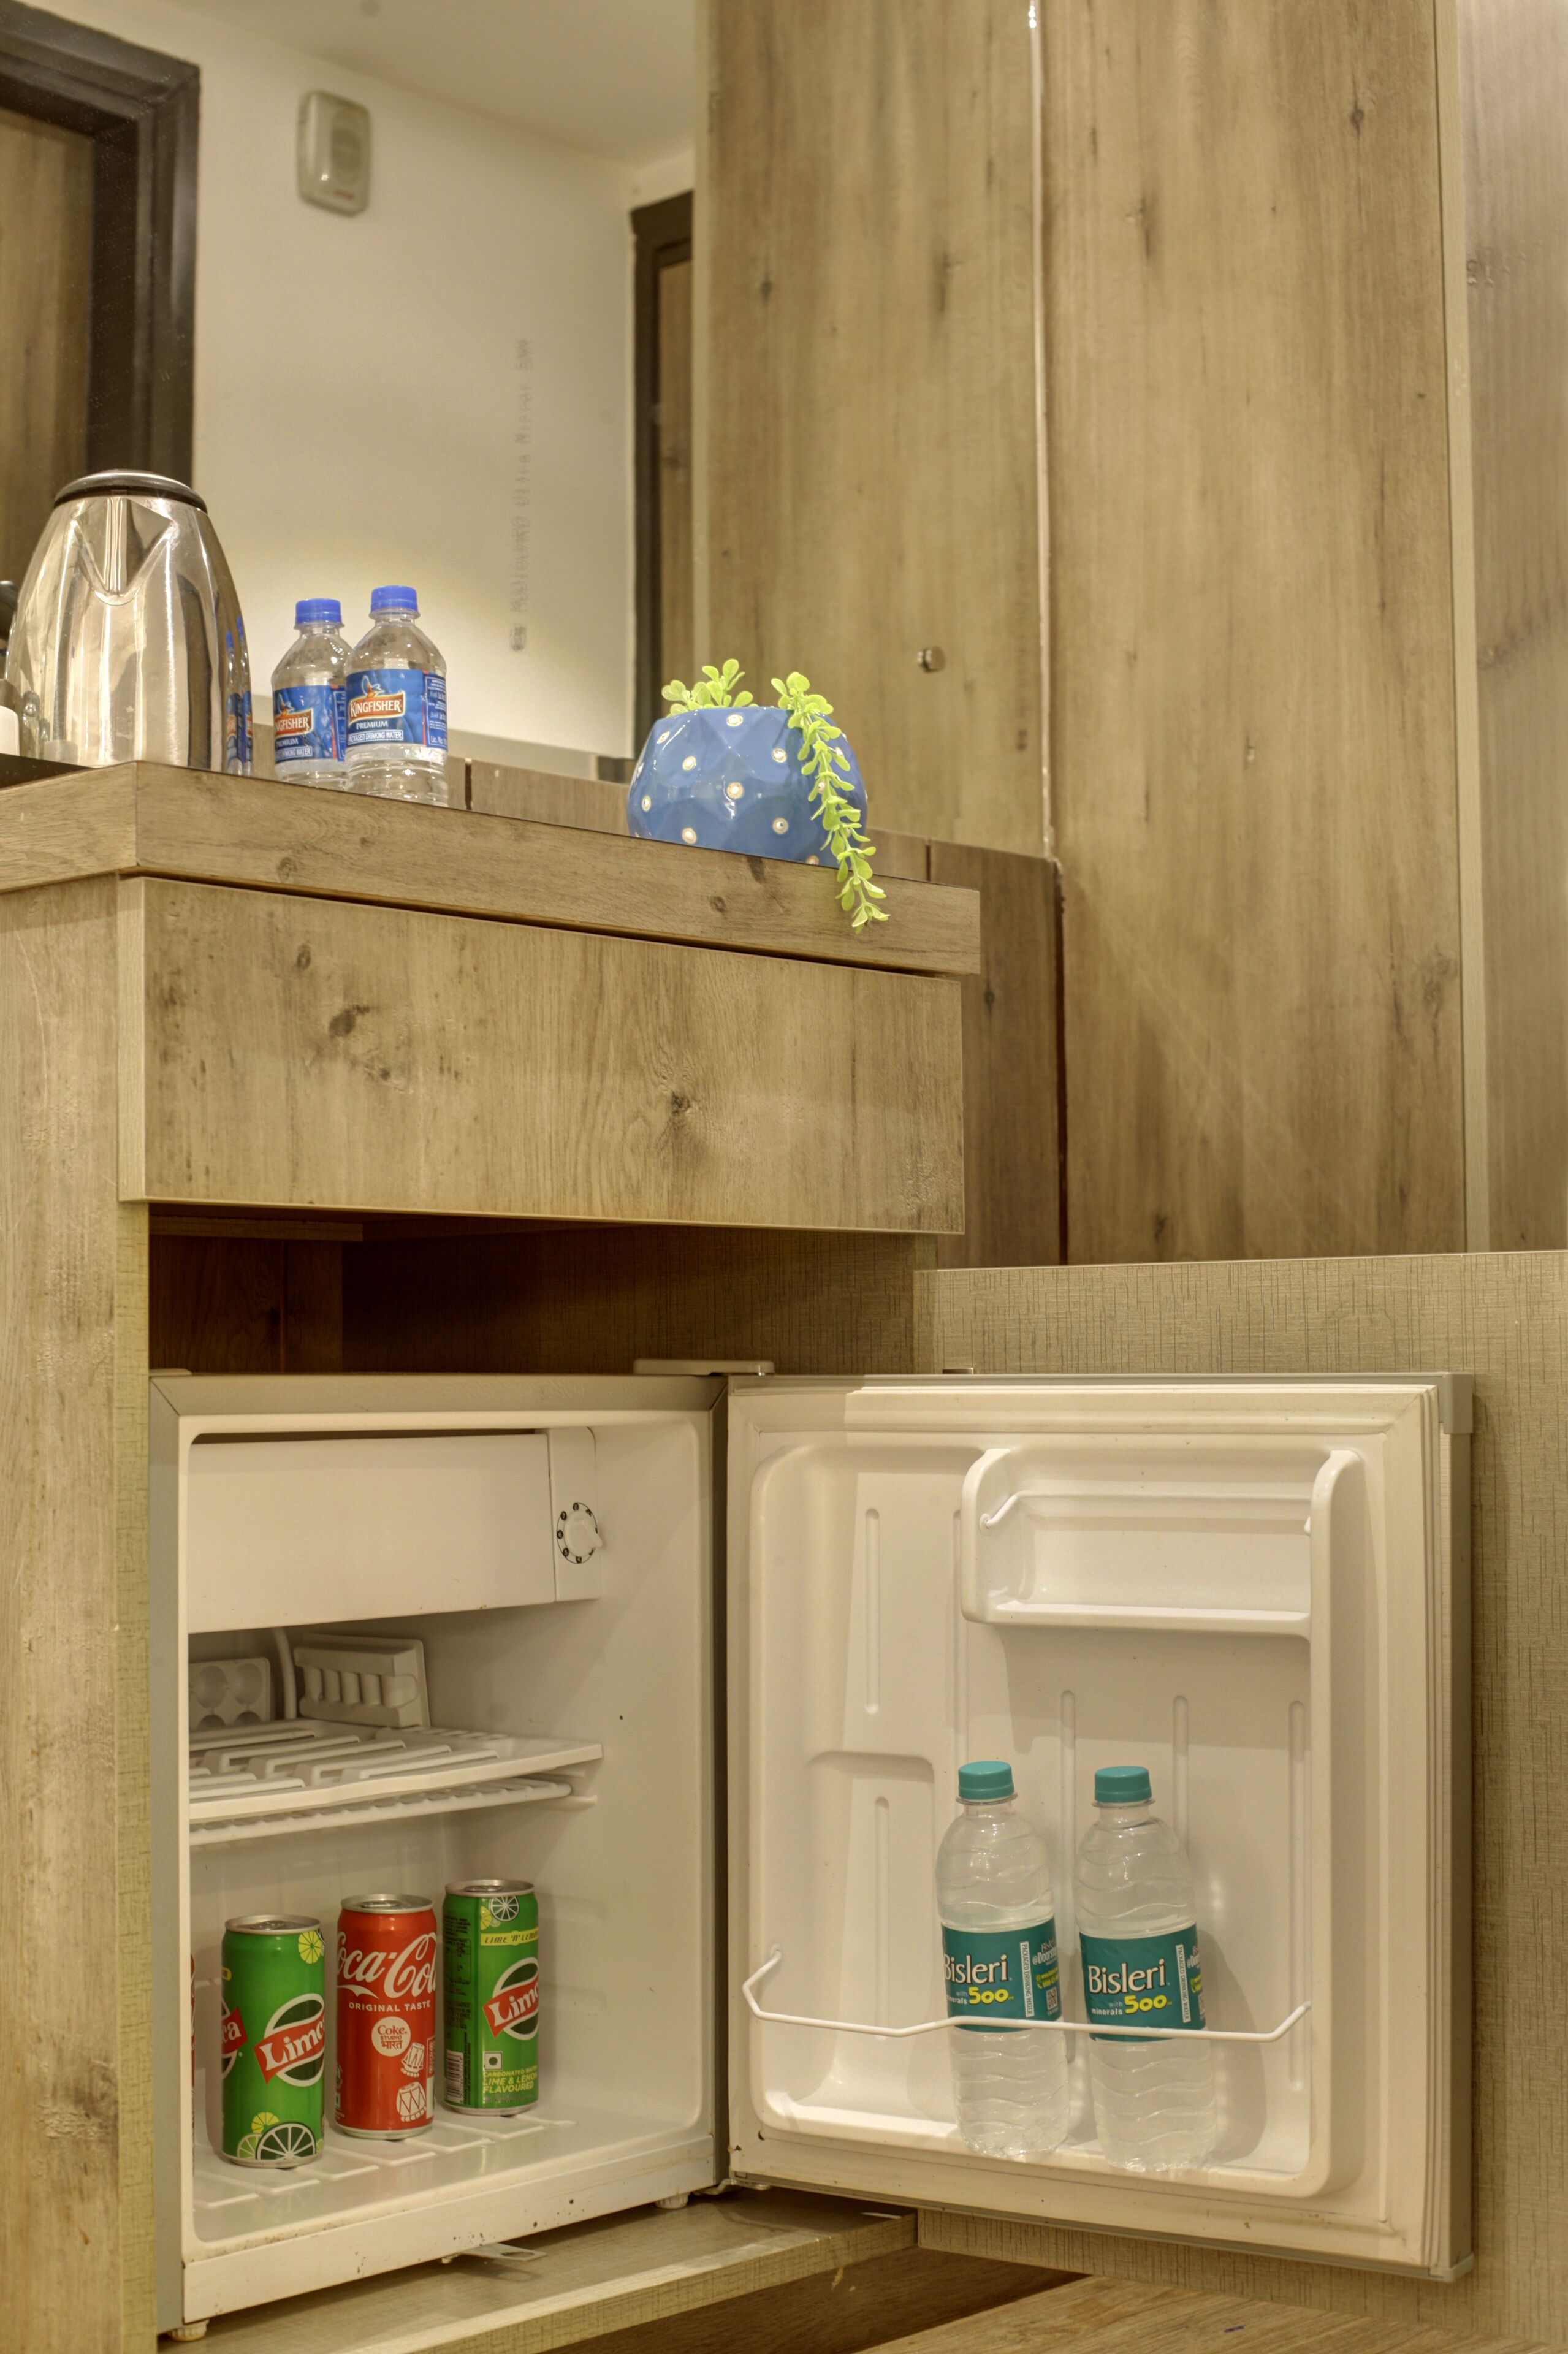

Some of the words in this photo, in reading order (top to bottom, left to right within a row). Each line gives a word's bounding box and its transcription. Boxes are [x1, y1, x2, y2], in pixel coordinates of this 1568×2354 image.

[351, 700, 401, 717] KINGFISHER
[356, 720, 388, 730] PREMIUM
[366, 731, 385, 740] DRINKING
[1021, 1944, 1030, 1970] PACKAGED
[944, 1954, 1007, 1984] Bisleri
[1088, 1958, 1165, 1994] Bisleri
[969, 1987, 1009, 2004] 500
[349, 2002, 400, 2012] ORIGINAL
[404, 2000, 430, 2011] TASTE
[1124, 1994, 1167, 2014] 500
[377, 2025, 405, 2035] Coke
[259, 2021, 324, 2071] Limc
[381, 2040, 403, 2050] भारत
[484, 2069, 525, 2078] CARBONATED
[483, 2077, 506, 2085] LIME
[484, 2081, 534, 2093] FLAVOURED
